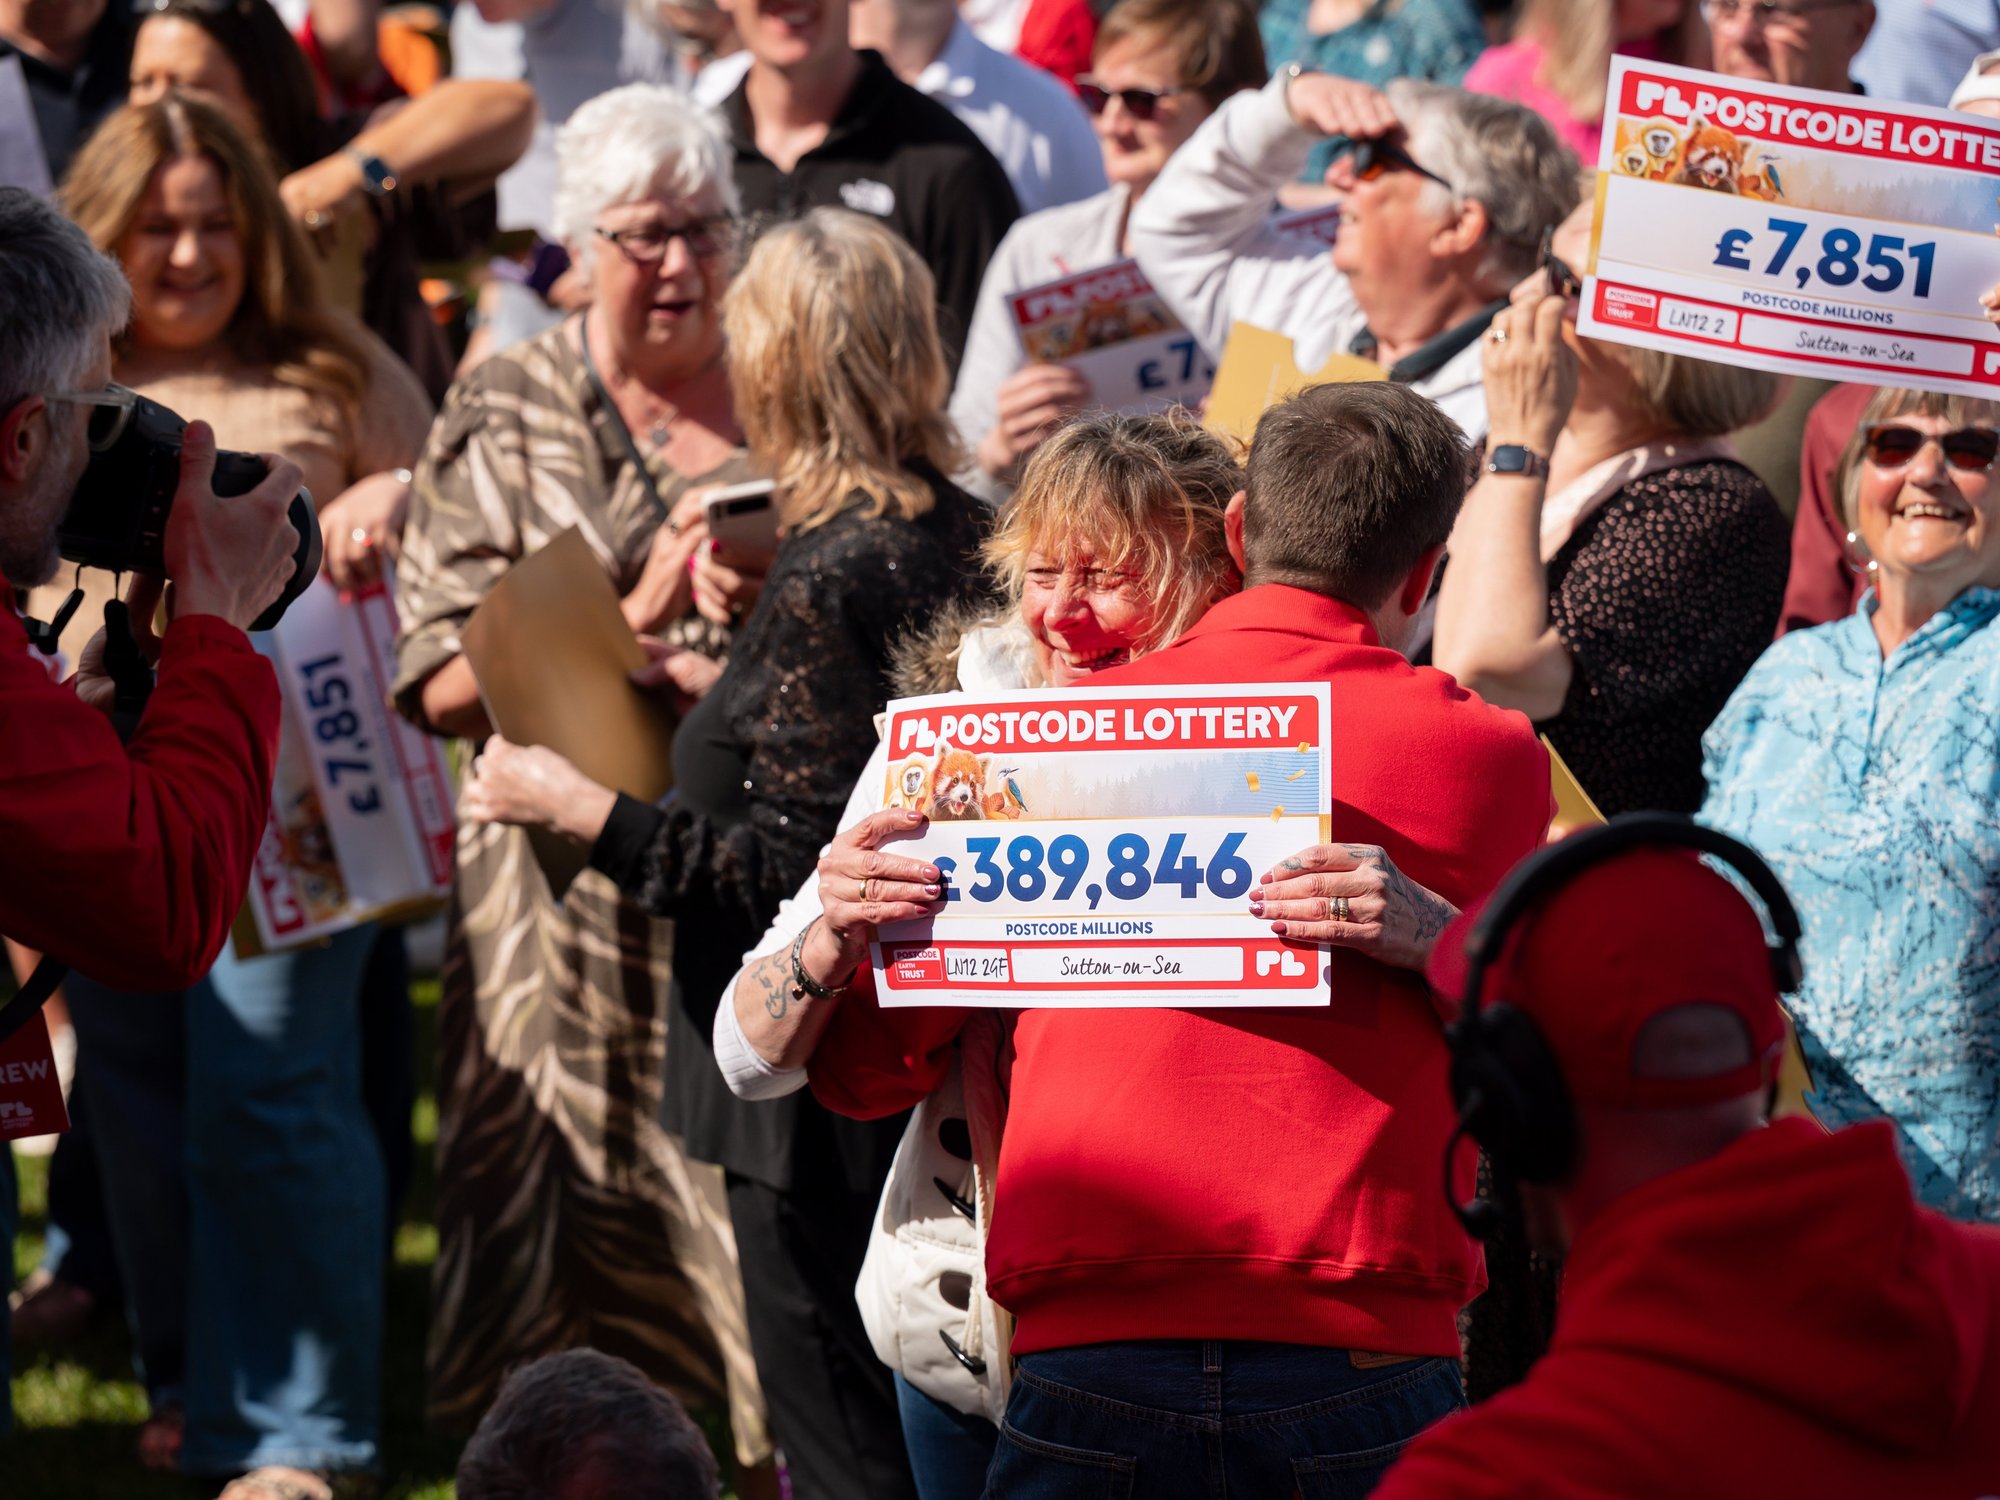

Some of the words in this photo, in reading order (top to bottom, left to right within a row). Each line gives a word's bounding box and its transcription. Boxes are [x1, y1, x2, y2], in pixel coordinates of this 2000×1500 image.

[1694, 90, 1886, 151] POSTCODE
[1712, 217, 1937, 298] £7,851
[1668, 308, 1709, 331] LN12
[1713, 318, 1725, 335] 2
[1742, 291, 1820, 315] POSTCODE
[1822, 303, 1894, 325] MILLIONS
[1795, 331, 1917, 362] Sutton-on-Sea
[297, 653, 382, 815] £7,851
[940, 709, 1116, 746] POSTCODE
[1124, 705, 1299, 741] LOTTERY
[932, 831, 1253, 910] £389,846
[1006, 923, 1078, 936] POSTCODE
[1081, 921, 1154, 935] MILLIONS
[896, 950, 938, 960] POSTCODE
[946, 957, 978, 976] LN12
[1060, 955, 1183, 976] Sutton-on-Sea
[899, 970, 926, 979] TRUST
